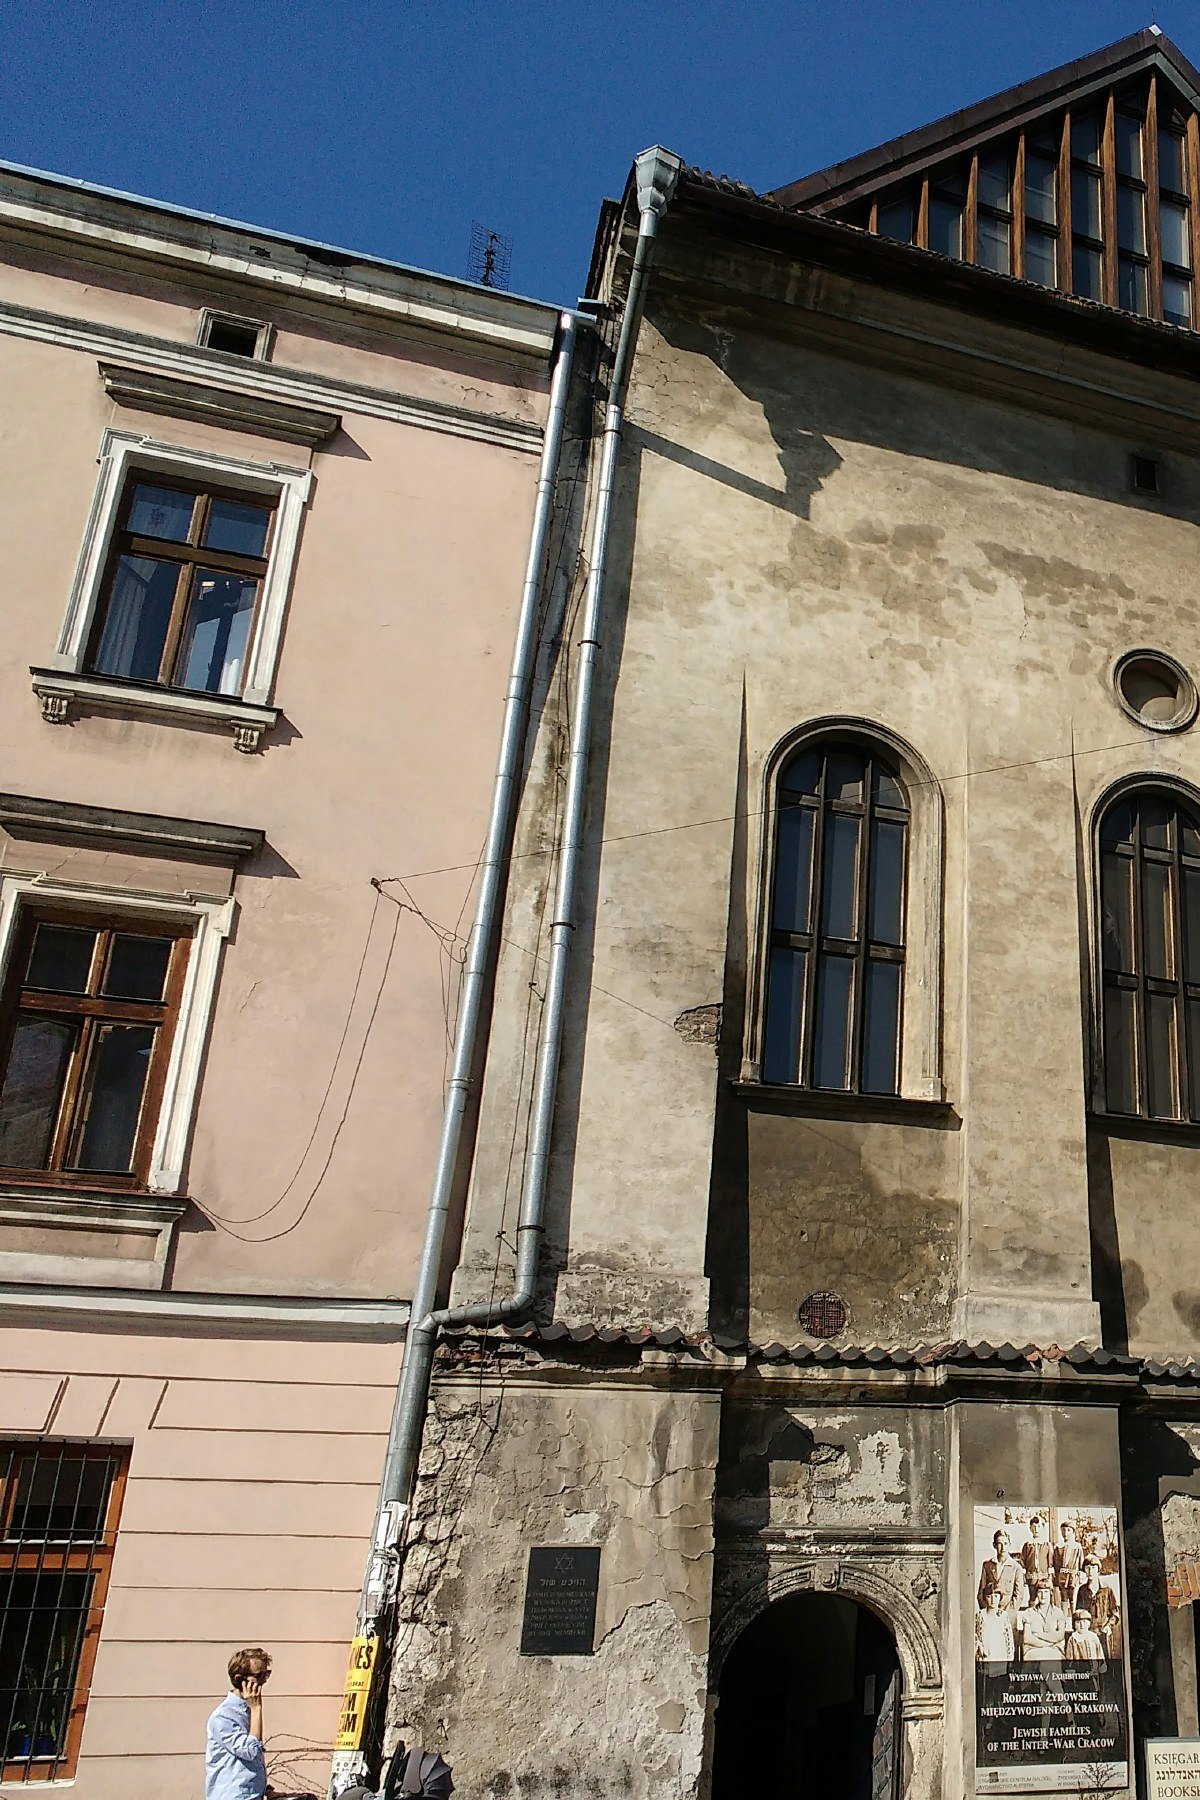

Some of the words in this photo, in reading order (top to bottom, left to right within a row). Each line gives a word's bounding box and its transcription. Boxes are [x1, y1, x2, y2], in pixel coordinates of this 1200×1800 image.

[1009, 1672, 1044, 1682] WYSTAWA
[1051, 1671, 1091, 1682] EXHIBITION
[1002, 1692, 1044, 1704] RODZINY
[1045, 1691, 1099, 1702] ŻYDOWSKIE
[980, 1705, 1072, 1718] MIĘDZYWOJENNEGO
[1074, 1703, 1120, 1714] KRAKOWA
[1012, 1726, 1048, 1739] JEWISH
[1050, 1726, 1091, 1737] FAMILIES
[987, 1742, 999, 1752] OF
[1001, 1741, 1020, 1751] THE
[1021, 1738, 1075, 1751] INTER-WAR
[1077, 1737, 1116, 1749] CRACOW
